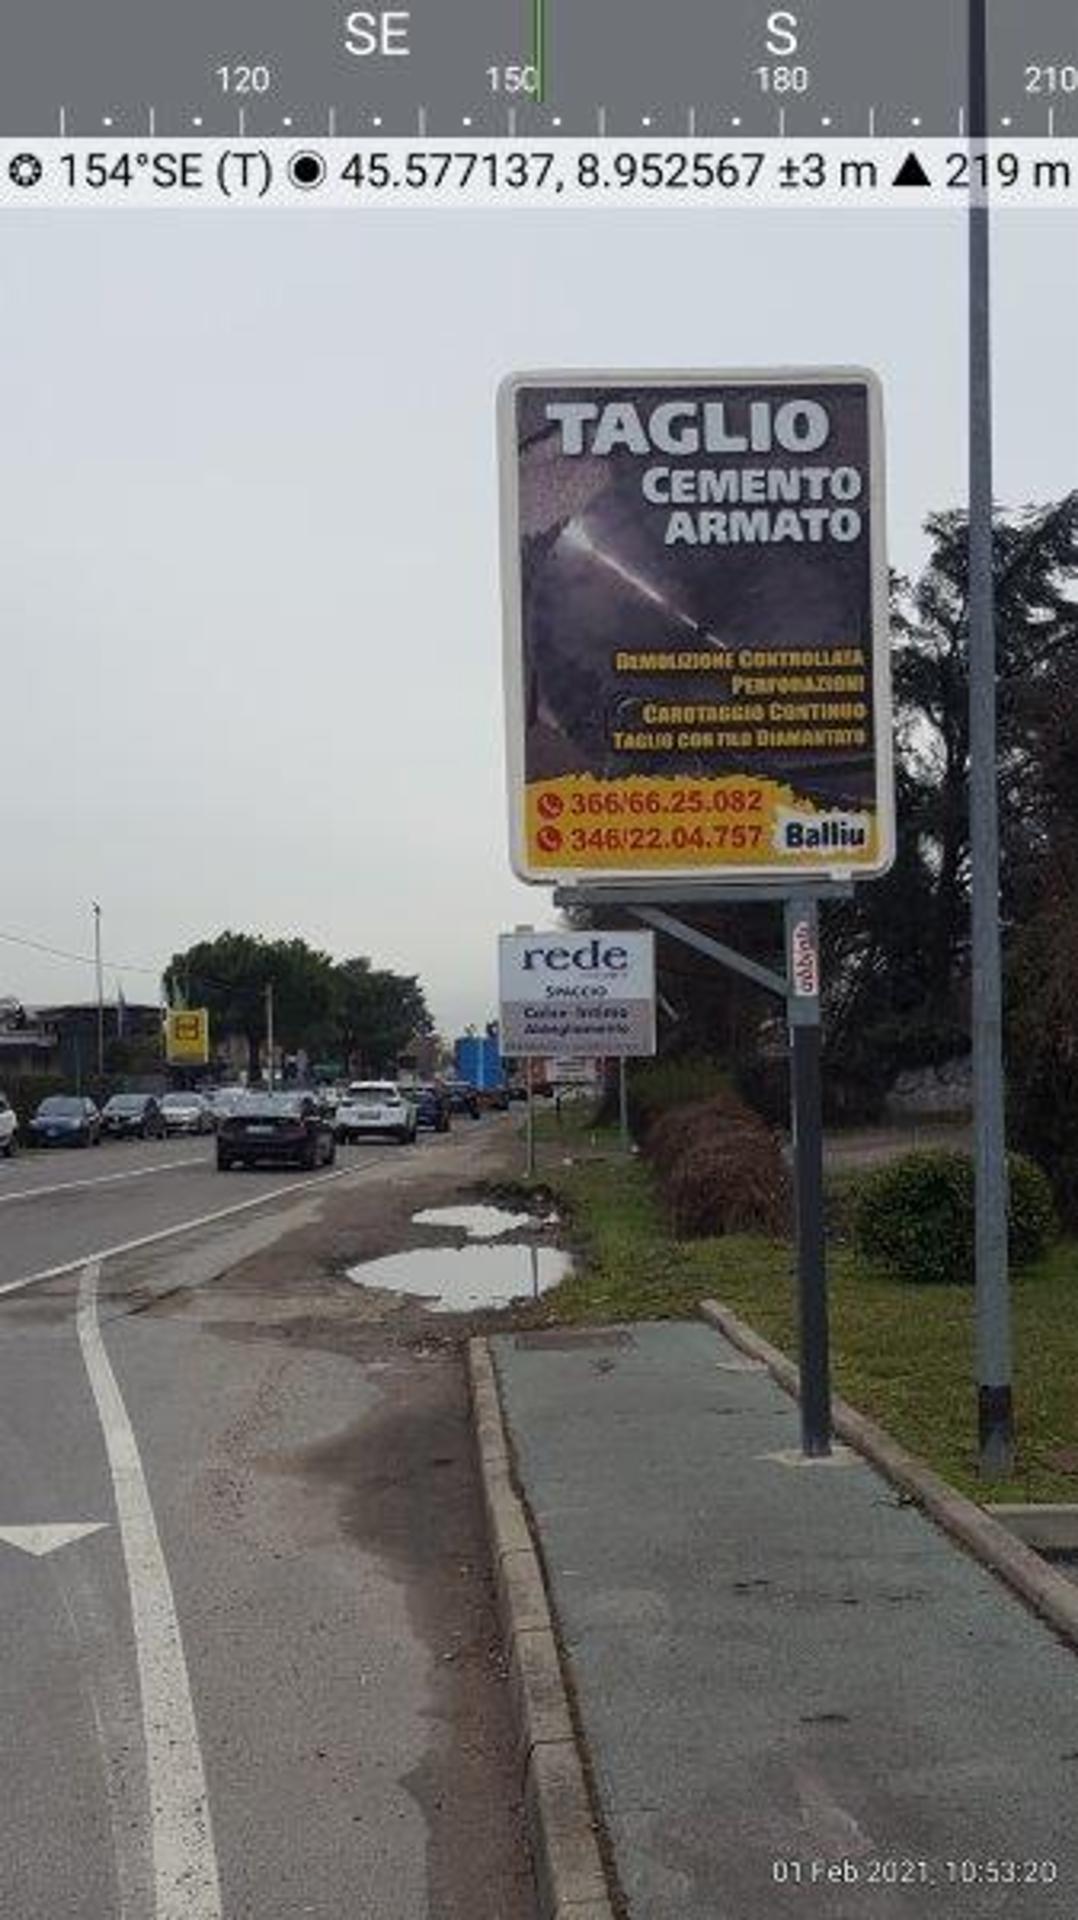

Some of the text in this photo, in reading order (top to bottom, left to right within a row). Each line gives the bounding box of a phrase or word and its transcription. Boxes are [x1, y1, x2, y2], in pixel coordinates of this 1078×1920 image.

[546, 400, 829, 456] TAGLIO
[642, 466, 862, 503] CEMENTO
[664, 508, 862, 545] ARMATO
[785, 821, 865, 848] Balliu
[522, 940, 628, 970] rede
